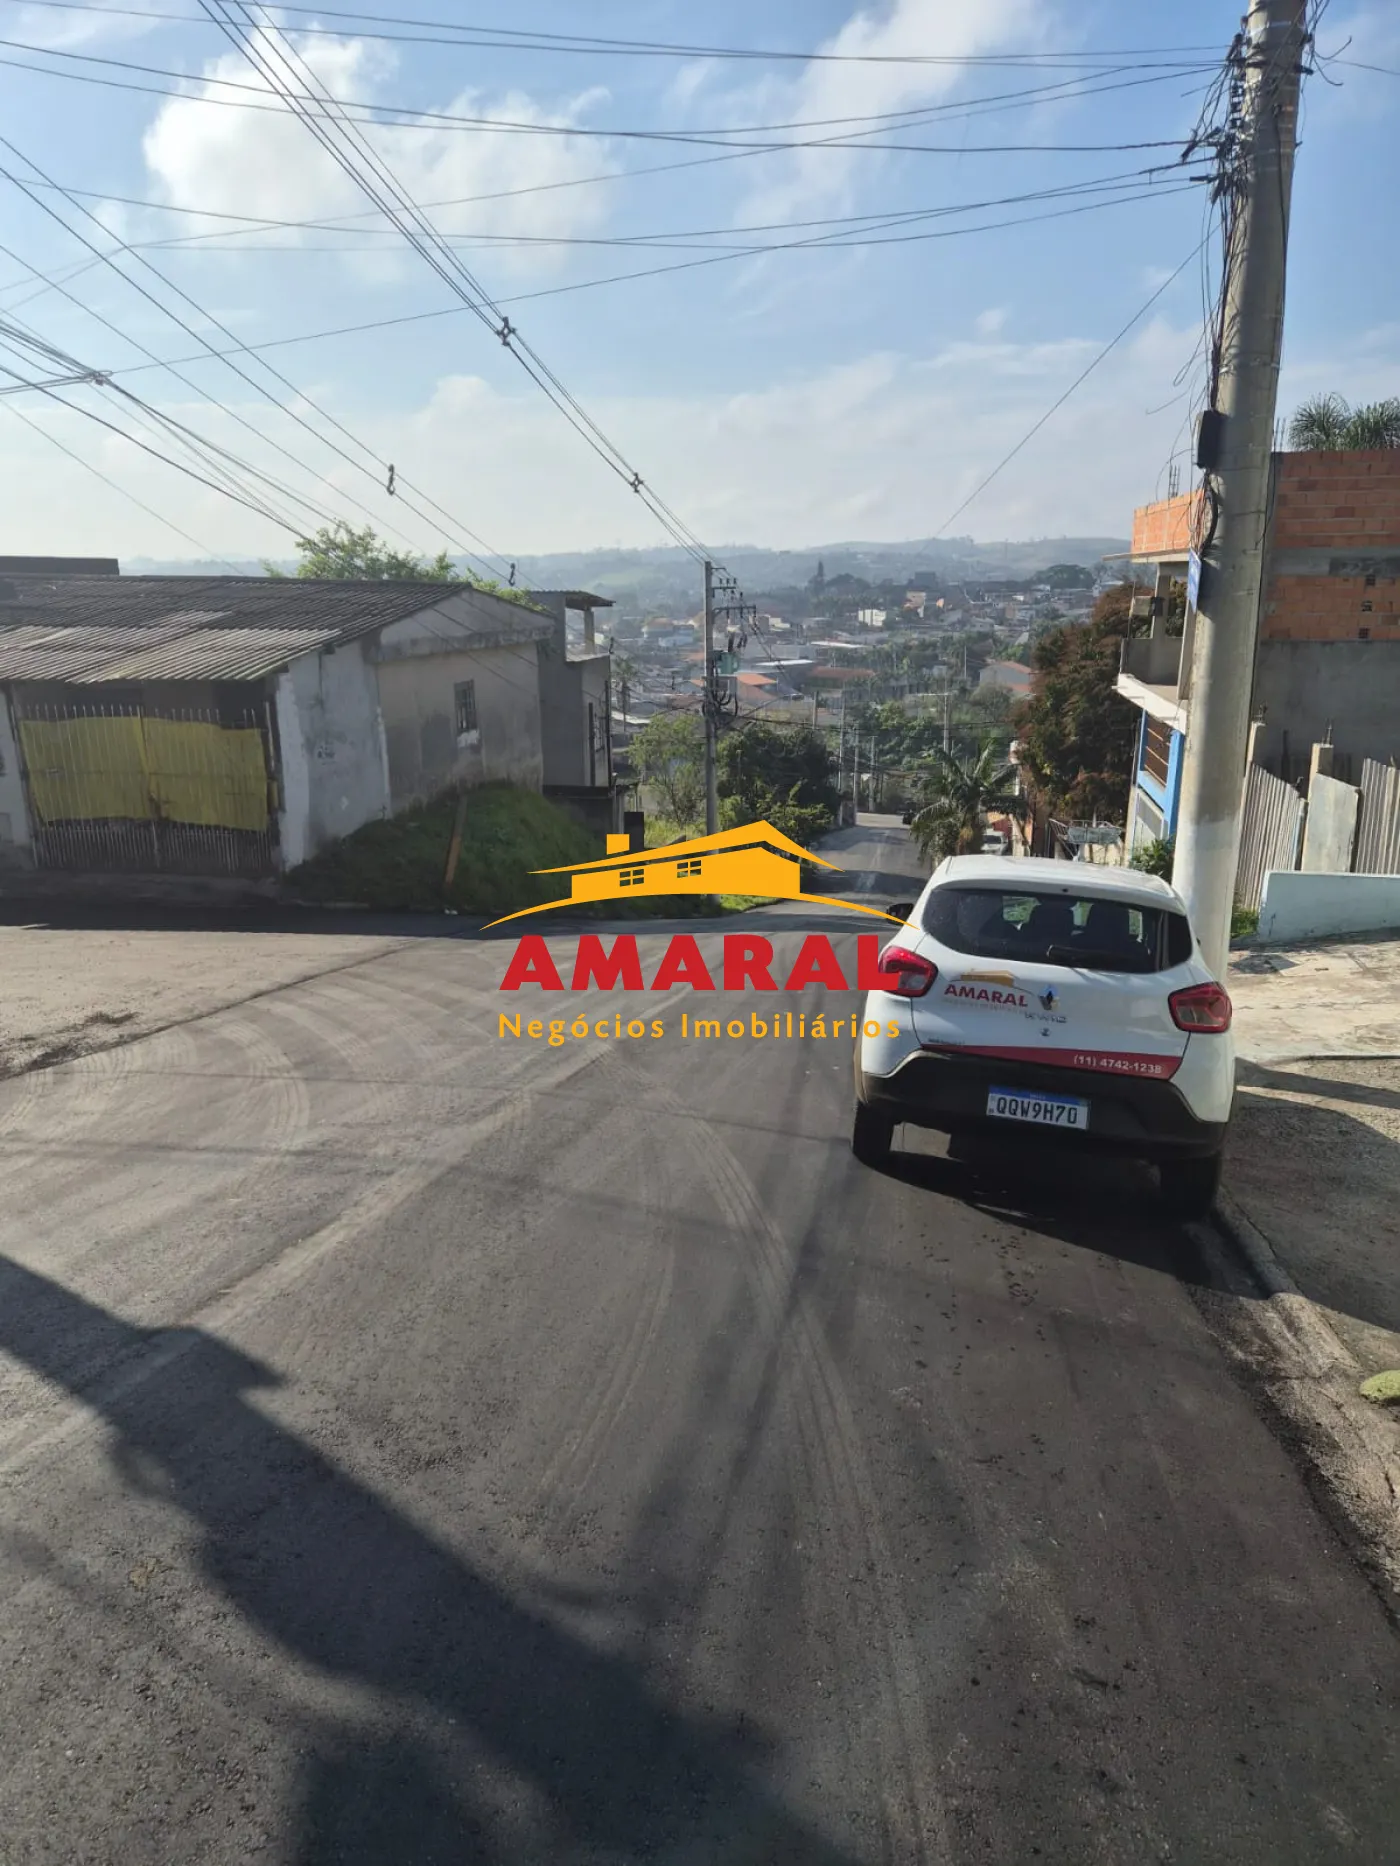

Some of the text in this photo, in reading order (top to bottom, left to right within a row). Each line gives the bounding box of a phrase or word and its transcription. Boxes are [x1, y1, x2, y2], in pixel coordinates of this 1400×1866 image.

[944, 983, 1028, 1008] AMARAL
[1073, 1054, 1097, 1067] (11)
[996, 1097, 1078, 1124] QQW9H70
